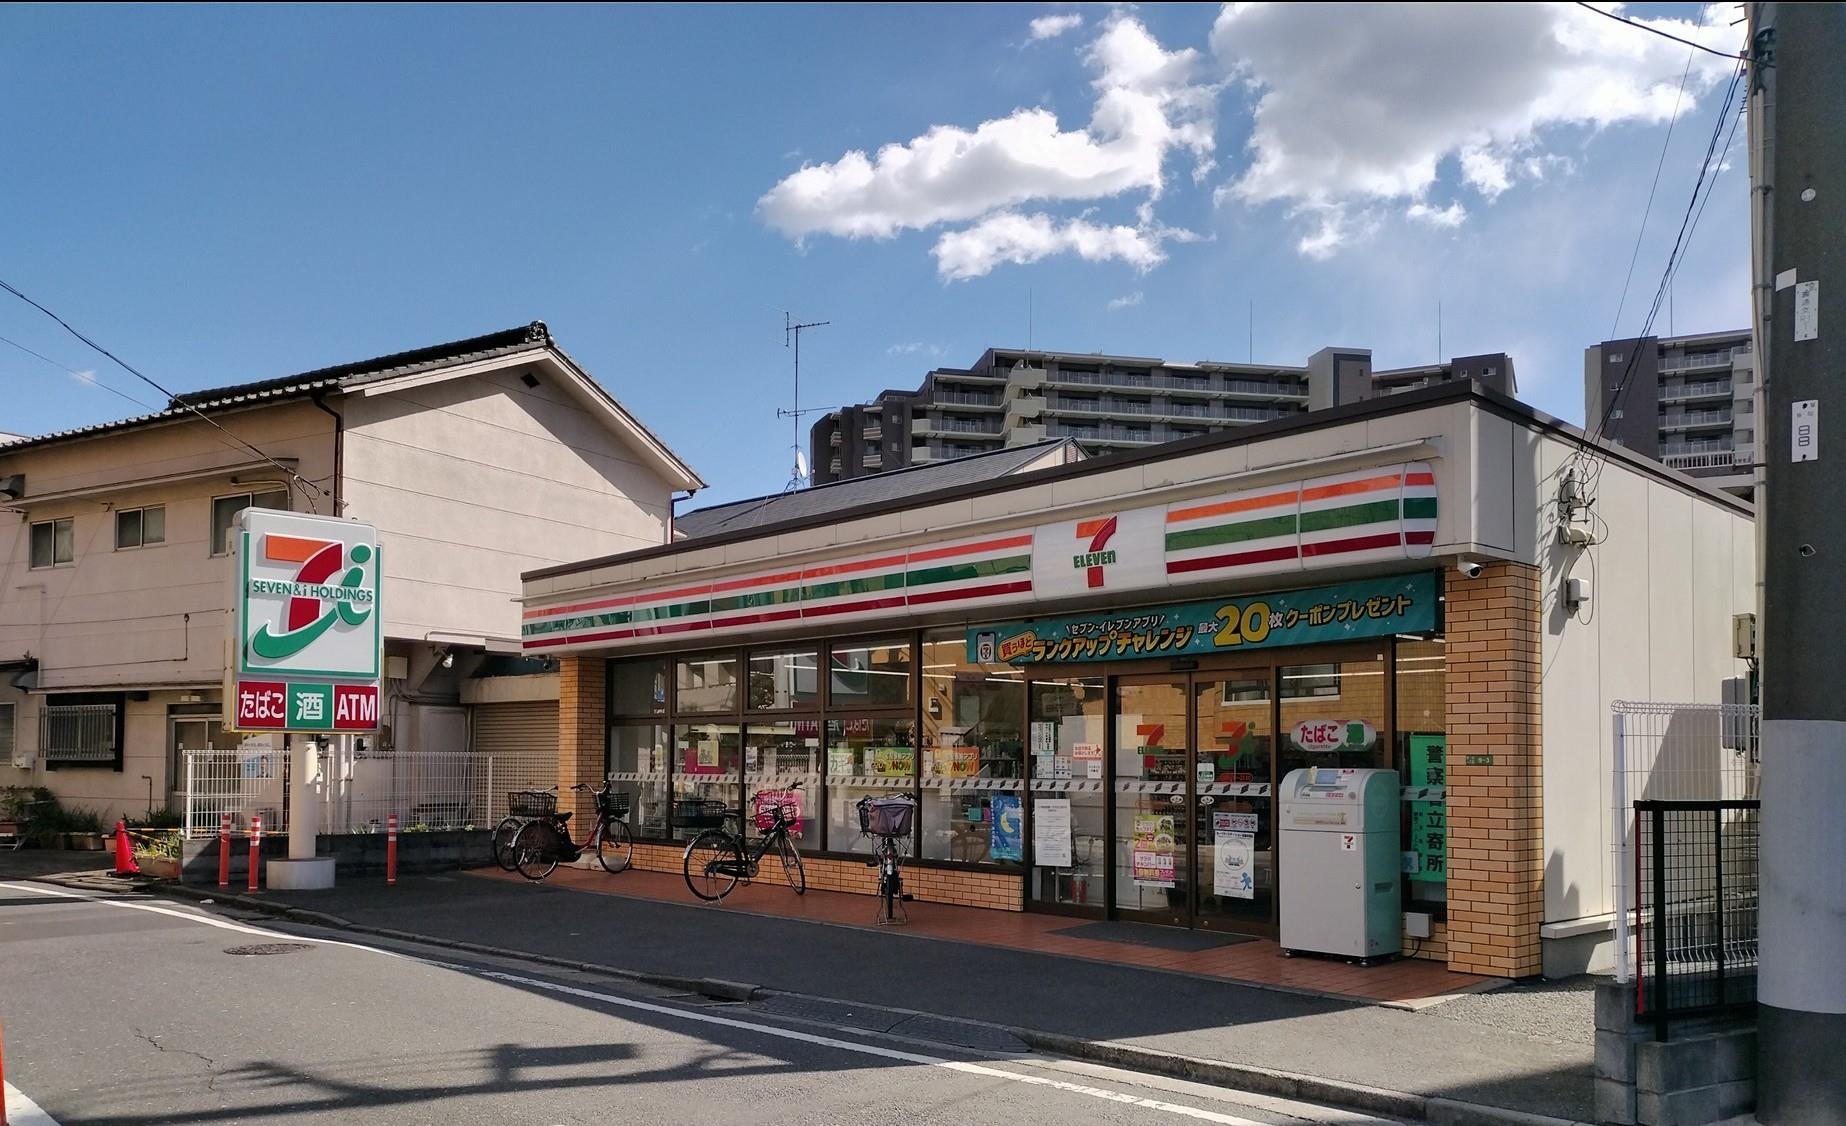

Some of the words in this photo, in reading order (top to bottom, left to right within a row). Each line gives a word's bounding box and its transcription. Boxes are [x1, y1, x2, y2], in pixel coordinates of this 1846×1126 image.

[310, 585, 374, 602] HOLDINGS
[1001, 635, 1034, 657] 買うほど
[1032, 627, 1193, 662] ランクアップチャレンジ
[240, 690, 284, 719] たばこ
[296, 692, 325, 721] 酒
[336, 694, 376, 722] ATM
[1301, 725, 1339, 743] たばこ
[1426, 745, 1444, 872] 警察立寄所
